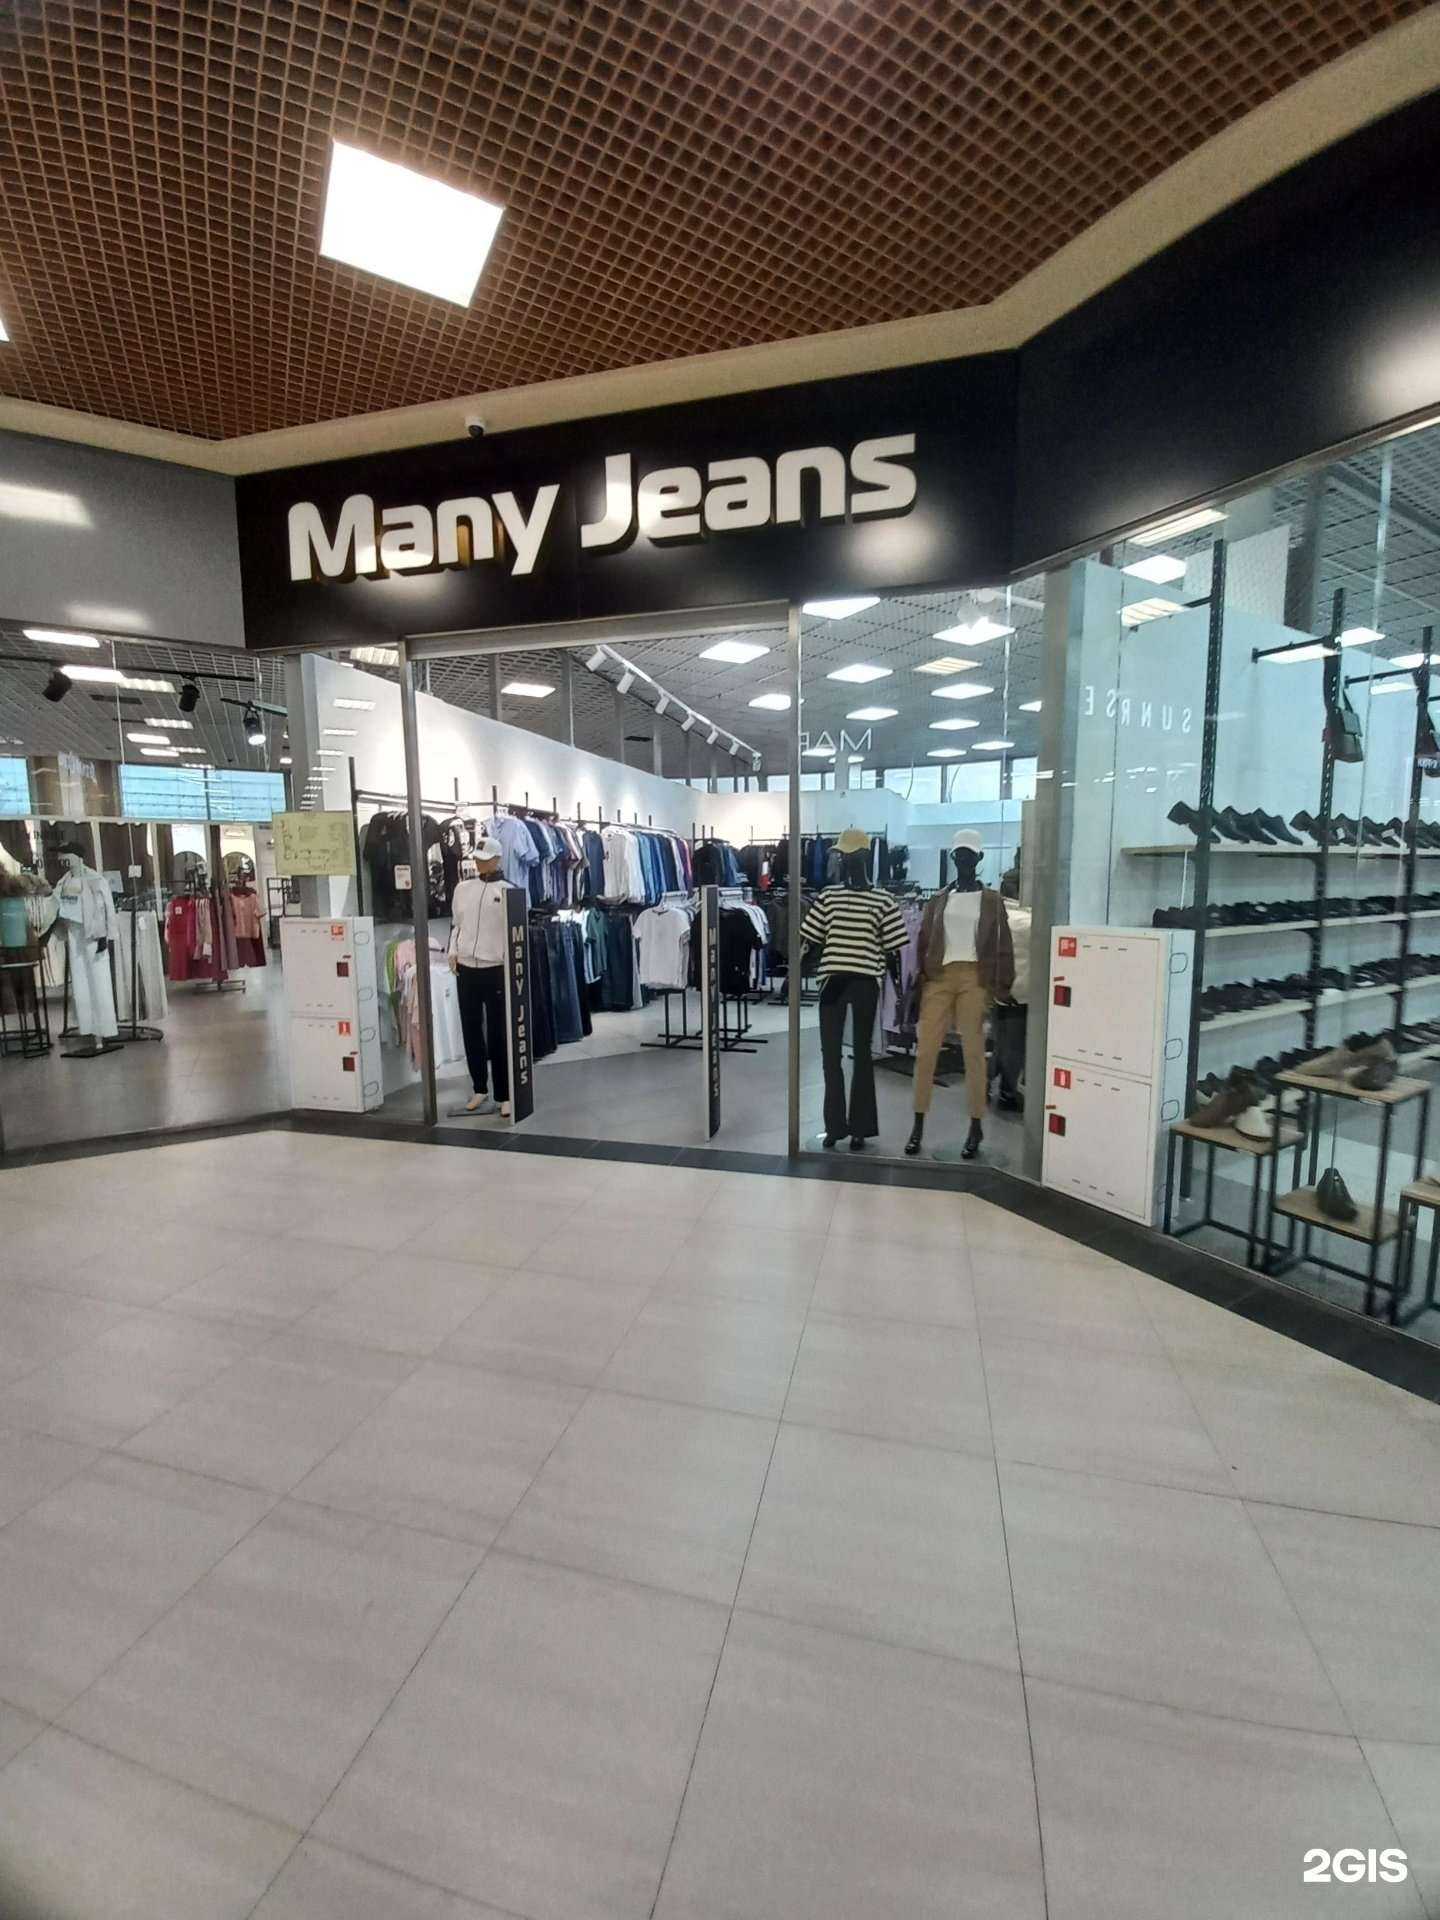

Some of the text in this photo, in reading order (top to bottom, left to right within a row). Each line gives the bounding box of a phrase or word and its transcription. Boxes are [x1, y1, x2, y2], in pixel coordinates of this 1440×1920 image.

[288, 433, 917, 582] Many Jeans
[511, 925, 528, 1085] Many Jeans
